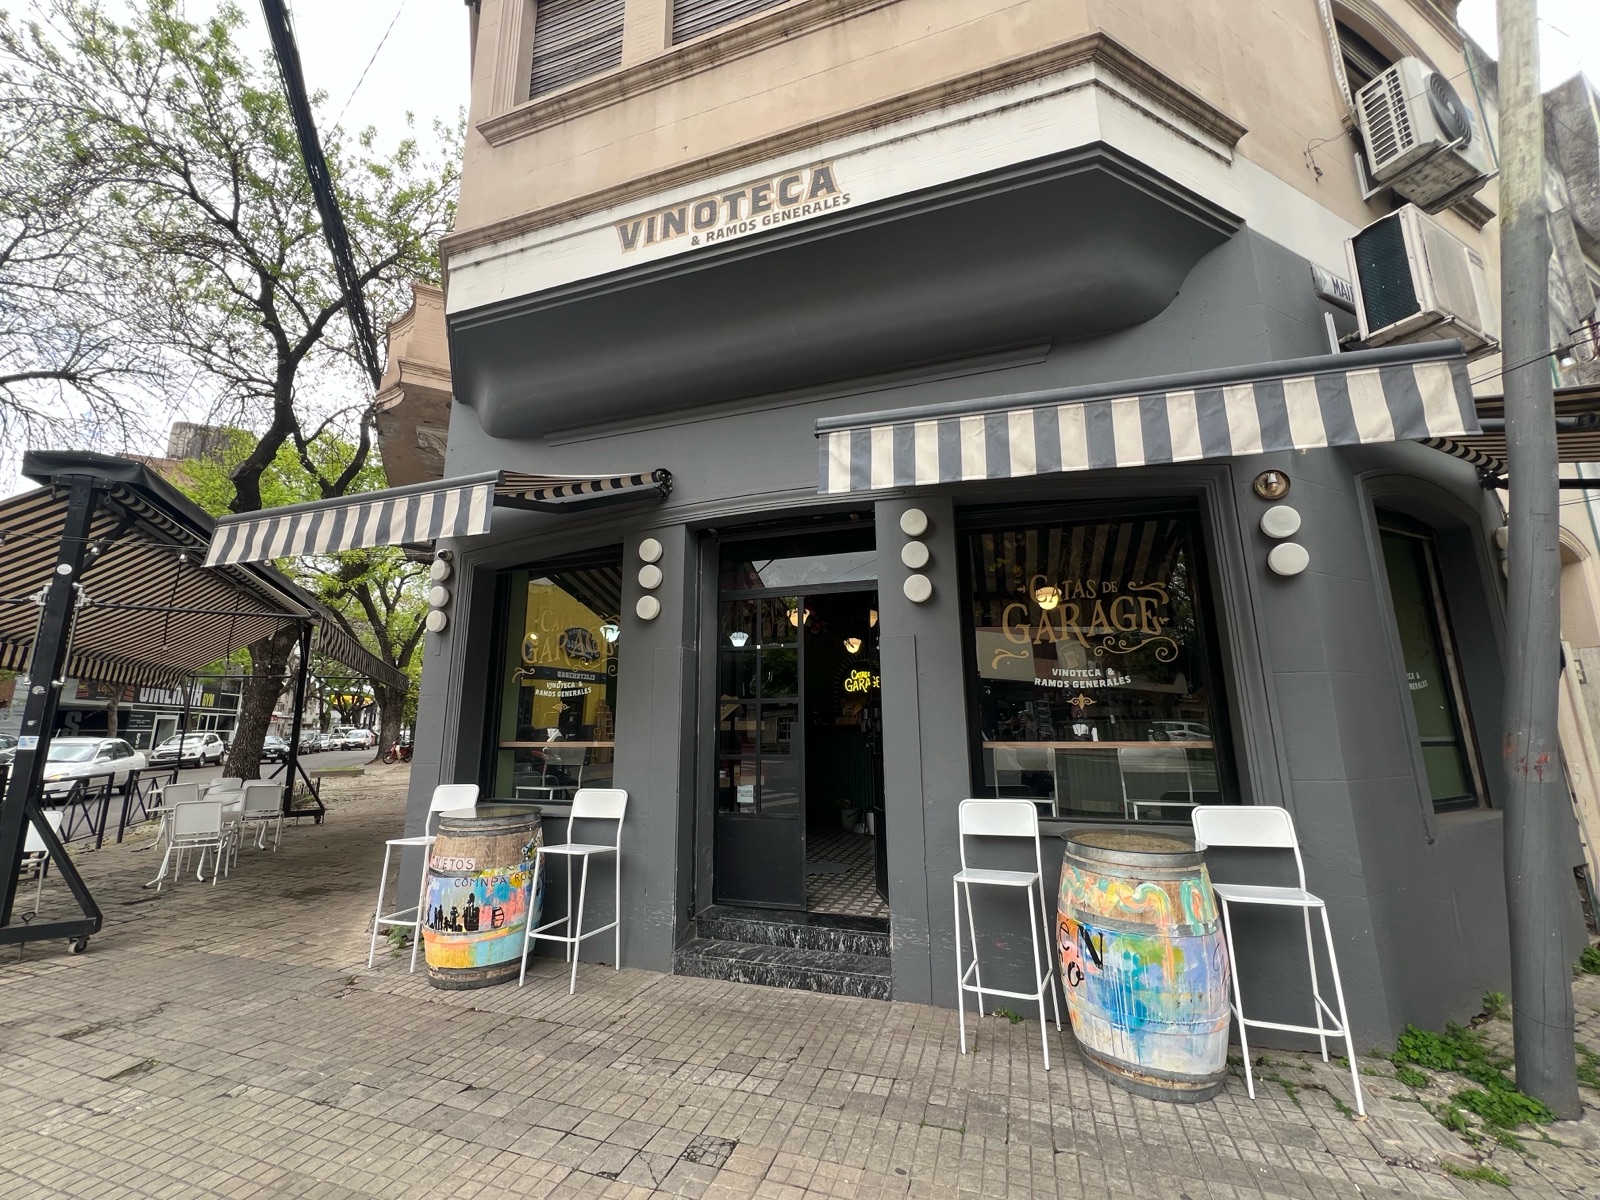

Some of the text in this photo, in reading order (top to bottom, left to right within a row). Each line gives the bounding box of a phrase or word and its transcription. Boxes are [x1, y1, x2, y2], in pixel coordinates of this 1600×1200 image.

[615, 161, 844, 254] VINOTECA
[691, 193, 851, 246] & RAMOS GENERALES
[1030, 574, 1118, 603] CATAS DE
[1002, 595, 1162, 649] GARAGE
[1034, 675, 1132, 688] RAMOS GENERALES
[1052, 667, 1115, 677] VINOTECA &
[535, 687, 592, 698] RAMOS GENERALES
[546, 681, 576, 689] VINOTECA
